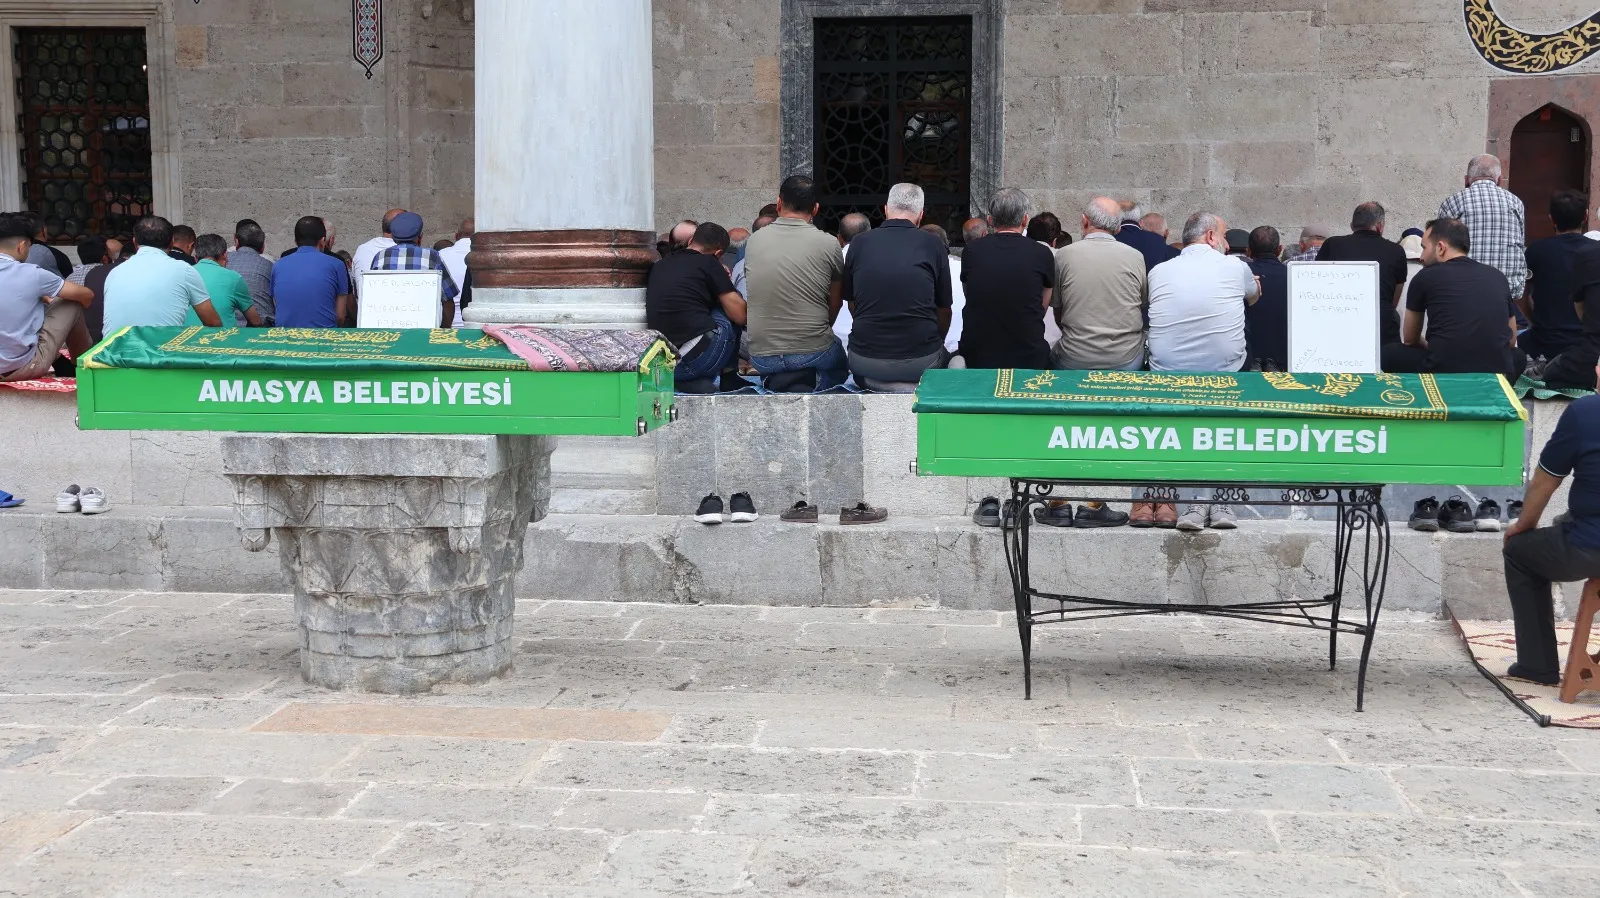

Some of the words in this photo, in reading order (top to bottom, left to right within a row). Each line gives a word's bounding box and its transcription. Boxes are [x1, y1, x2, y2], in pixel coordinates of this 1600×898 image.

[198, 379, 324, 403] AMASYA
[333, 377, 512, 405] BELEDİYESİ
[1048, 426, 1182, 450] AMASYA
[1193, 424, 1388, 454] BELEDİYESİ
